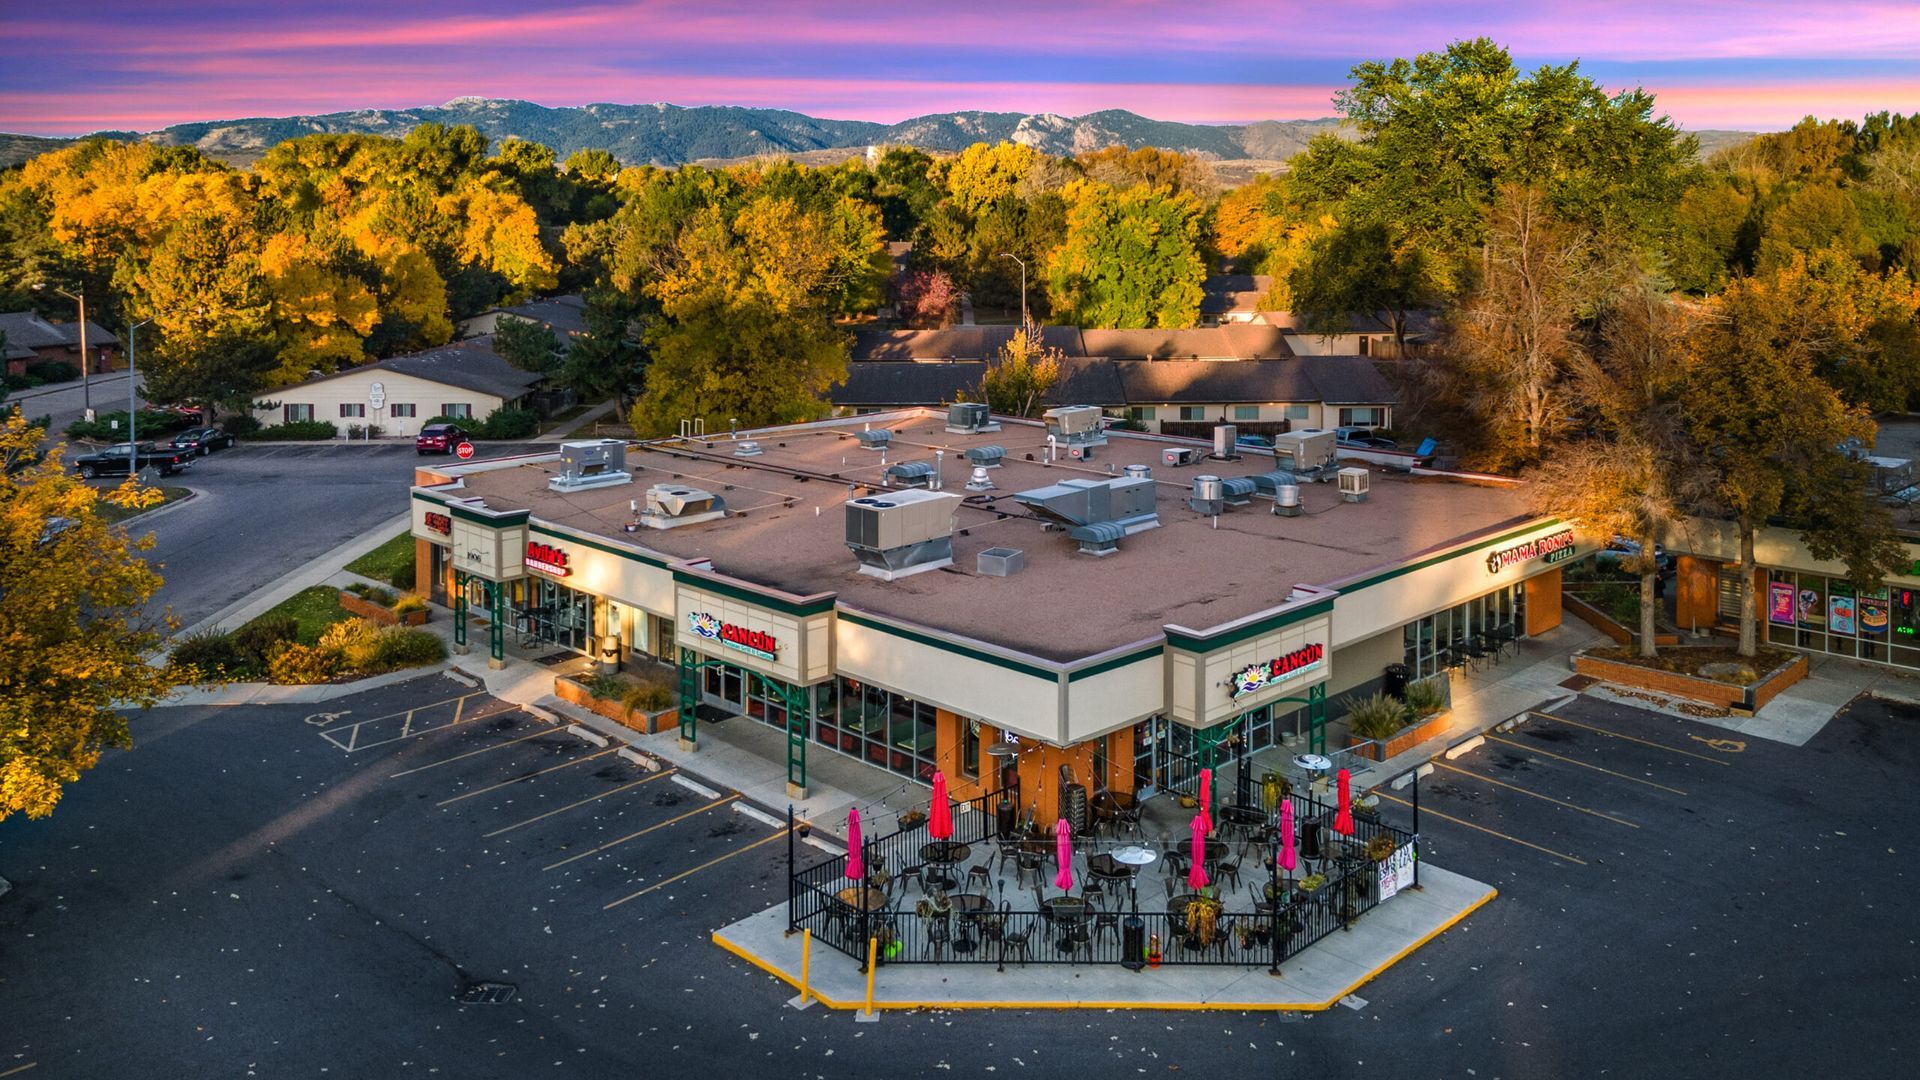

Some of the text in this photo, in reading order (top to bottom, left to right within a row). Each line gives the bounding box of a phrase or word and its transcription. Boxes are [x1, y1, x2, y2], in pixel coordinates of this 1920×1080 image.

[457, 446, 474, 455] STOP
[527, 541, 567, 567] Avila's
[1501, 530, 1574, 566] MAMA RONI'S
[1549, 546, 1574, 563] PIZZA
[525, 557, 567, 577] BARBERSHOP
